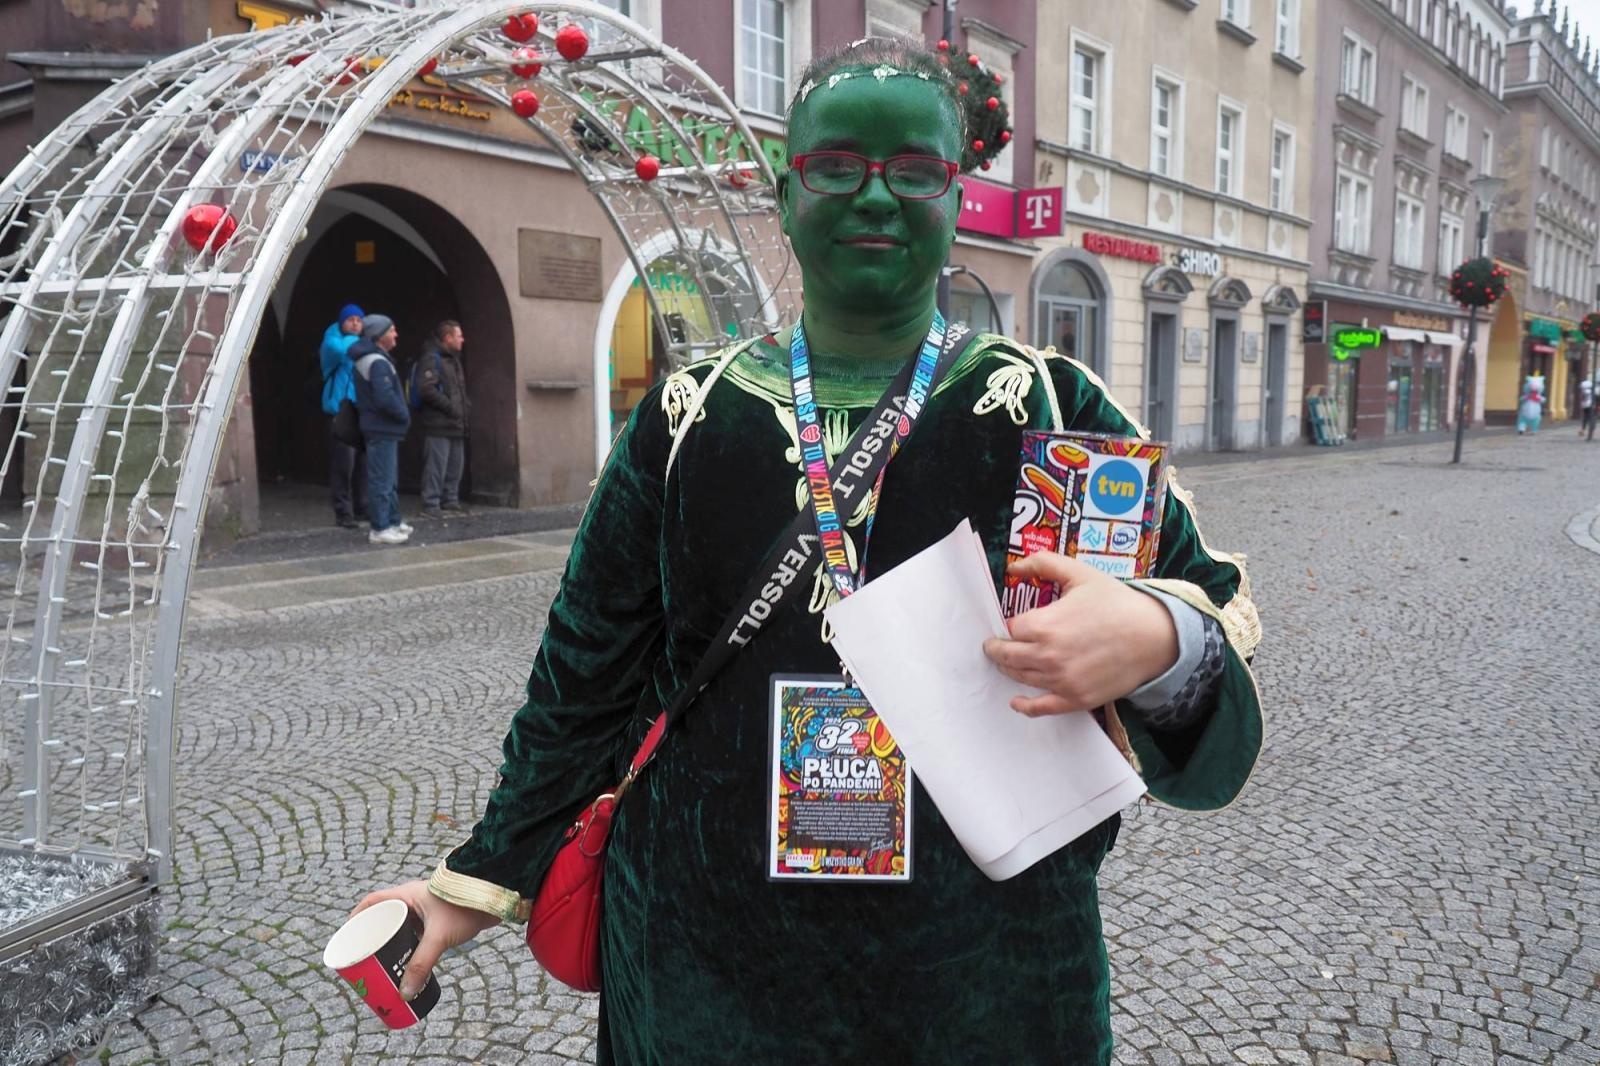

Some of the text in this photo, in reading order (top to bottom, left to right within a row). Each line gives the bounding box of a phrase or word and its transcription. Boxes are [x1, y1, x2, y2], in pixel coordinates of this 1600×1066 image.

[1026, 195, 1053, 229] T
[1180, 248, 1220, 275] SHIRO
[904, 343, 940, 420] WSPIERAM
[794, 377, 817, 424] WOŚP
[804, 444, 824, 461] TU
[807, 460, 837, 522] WSZYSTKO
[1098, 475, 1136, 498] tvn
[727, 396, 908, 648] VERSOLI VERSOLI
[819, 522, 843, 549] GRA
[825, 549, 849, 573] OK!
[1084, 557, 1128, 574] layer
[818, 720, 860, 750] 32
[804, 758, 881, 779] PŁUCA
[803, 778, 882, 790] PO PANDEMII
